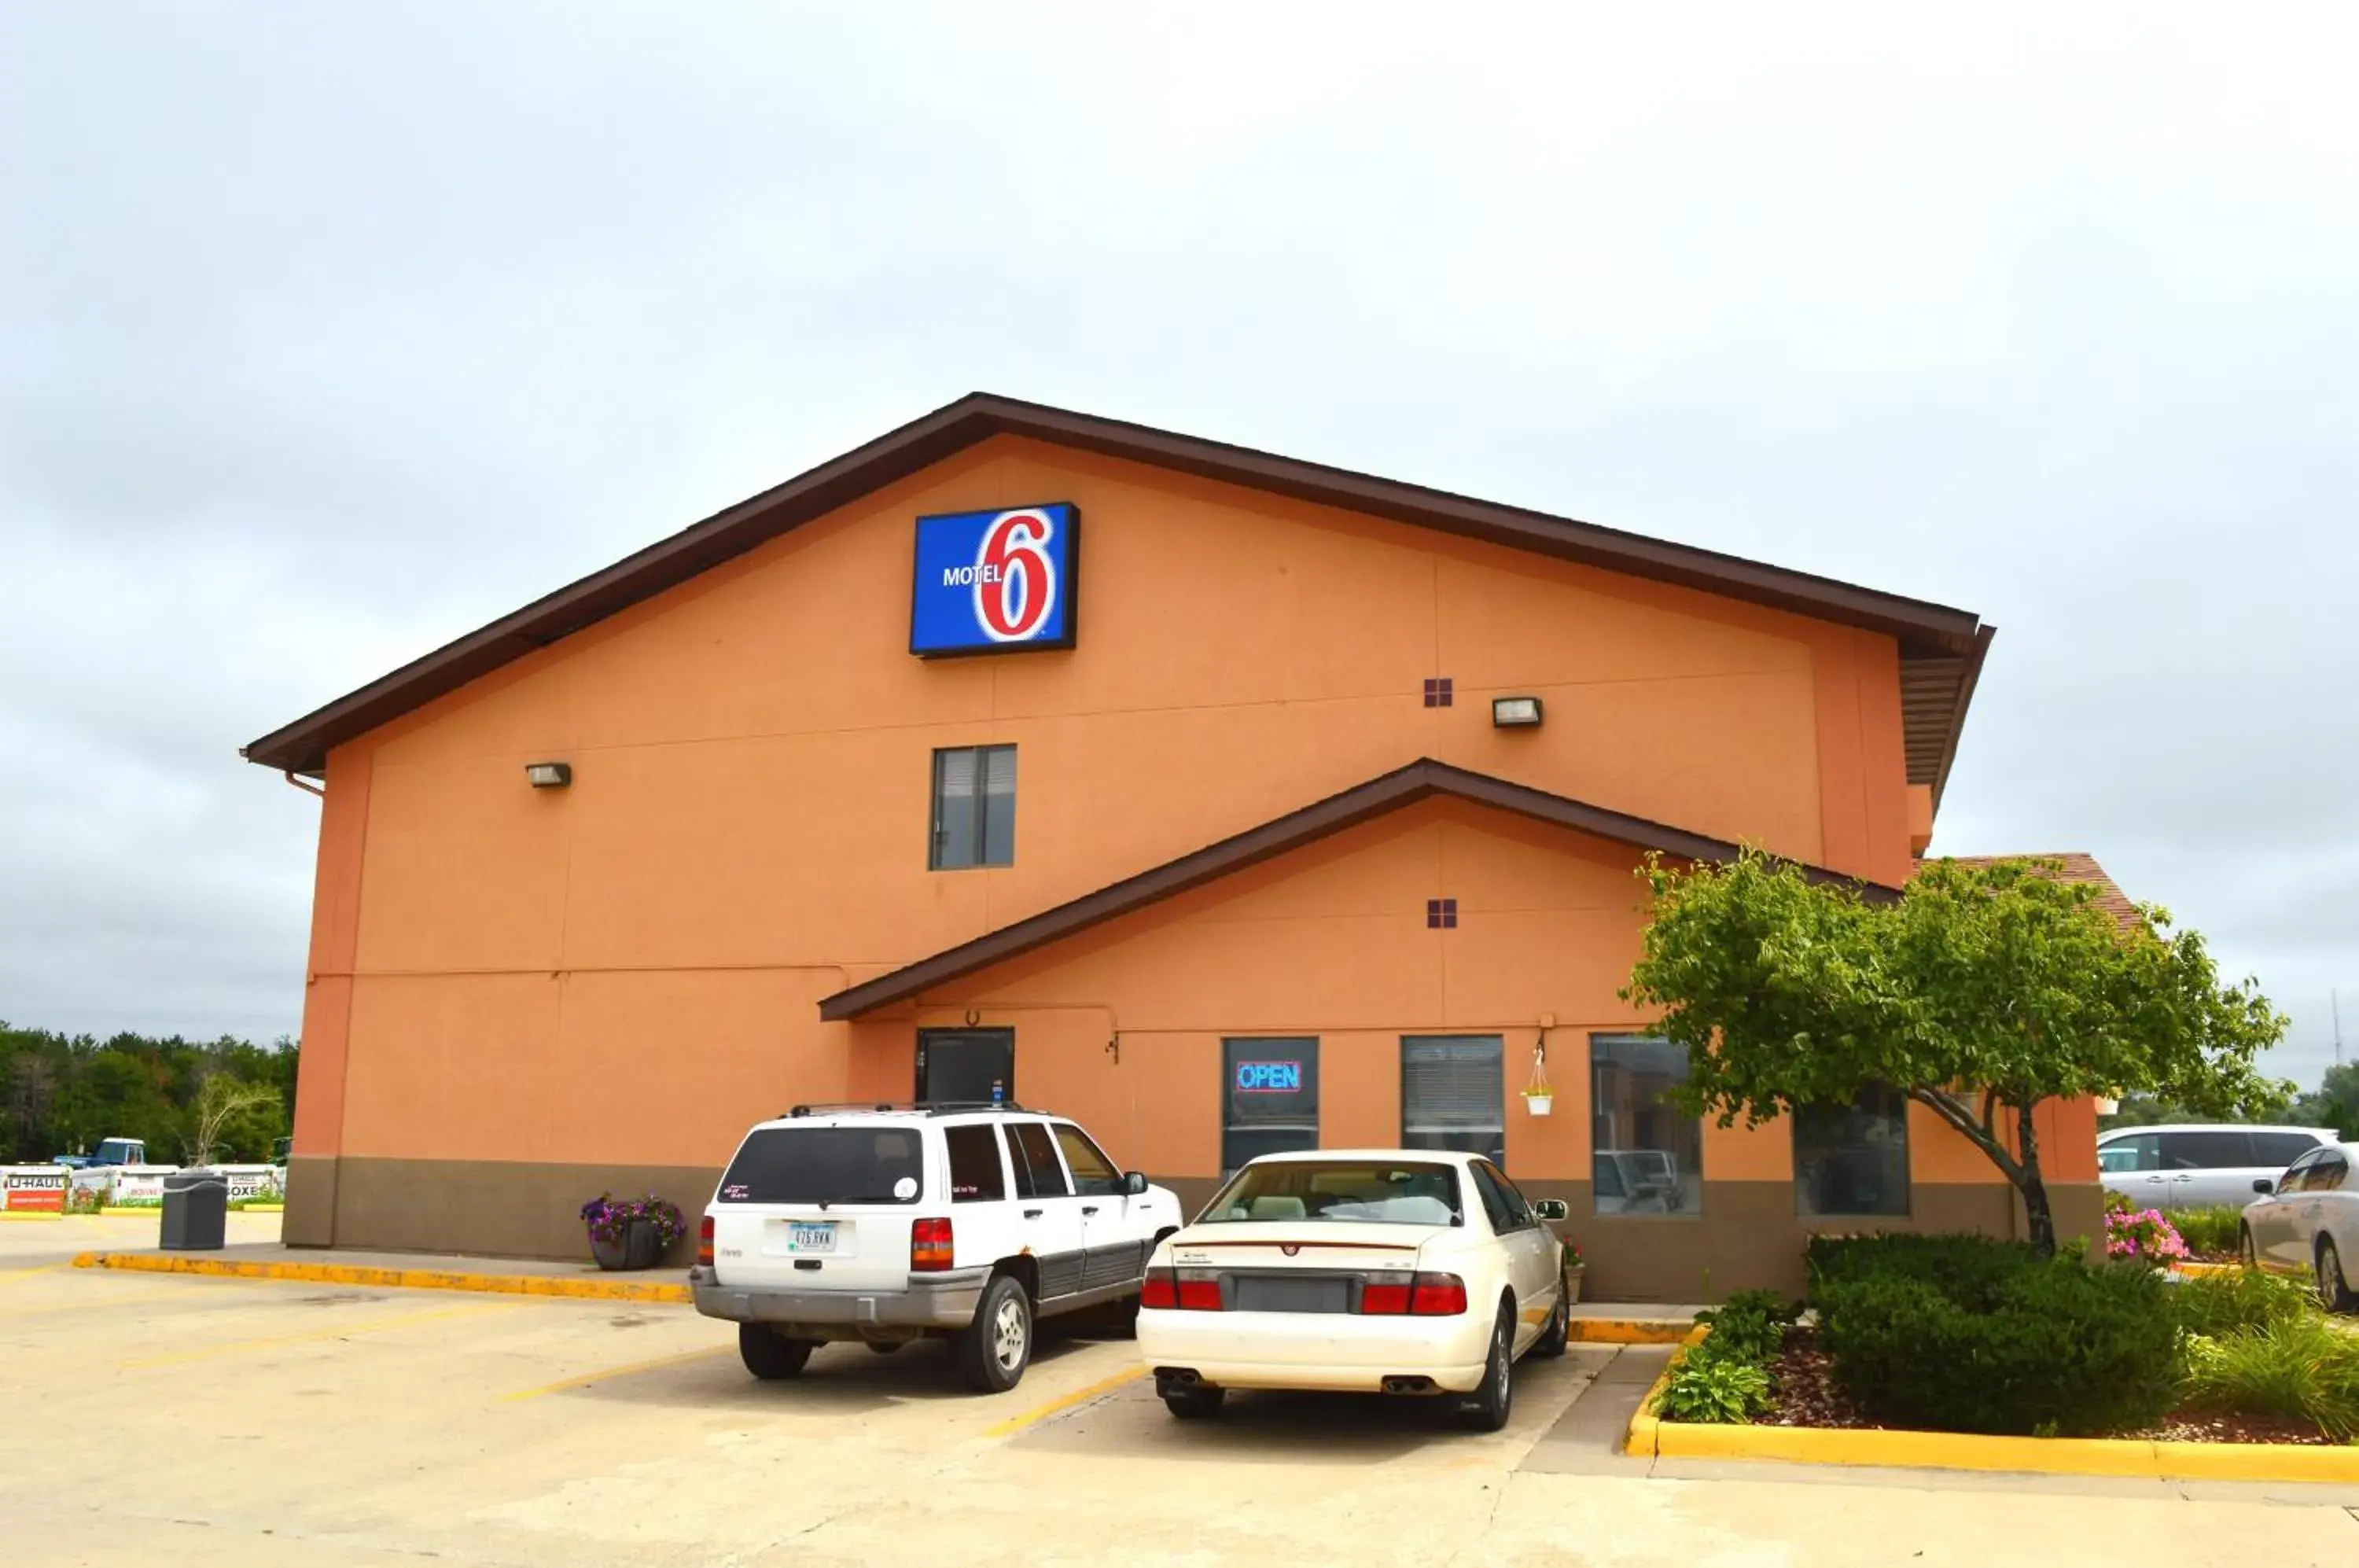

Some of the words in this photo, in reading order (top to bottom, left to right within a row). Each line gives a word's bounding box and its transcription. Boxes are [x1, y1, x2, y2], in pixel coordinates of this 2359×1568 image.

[944, 564, 1002, 586] MOTEL
[977, 512, 1051, 639] 6
[1238, 1064, 1298, 1089] OPEN
[9, 1176, 62, 1188] U-HAUL
